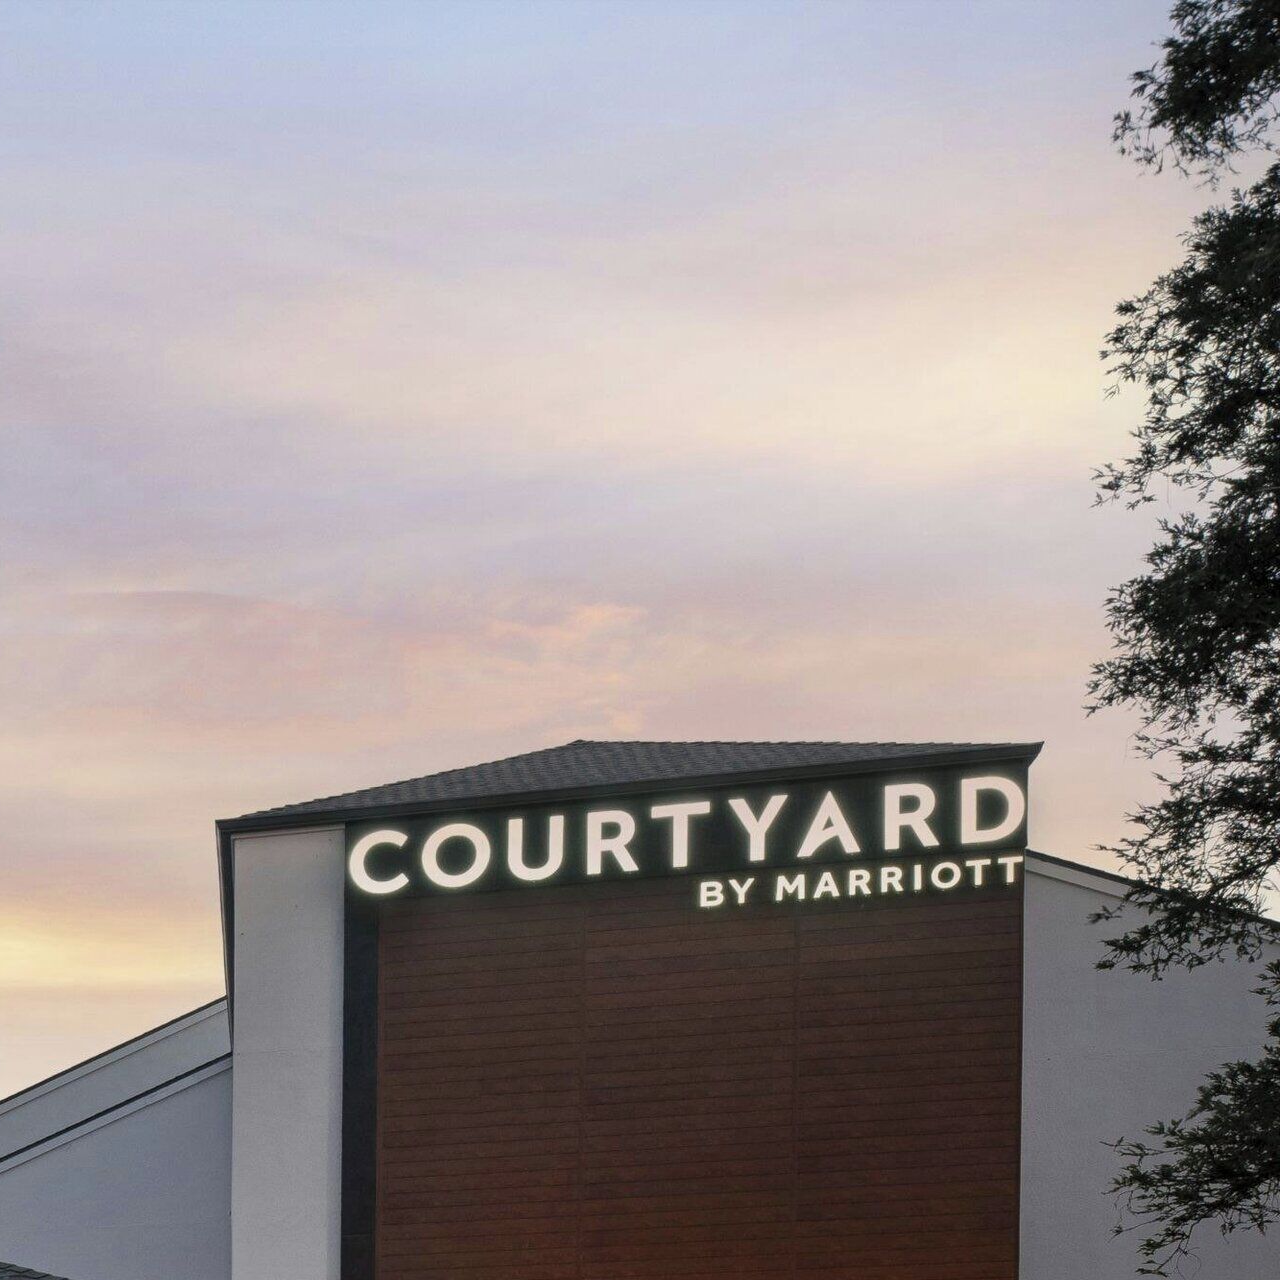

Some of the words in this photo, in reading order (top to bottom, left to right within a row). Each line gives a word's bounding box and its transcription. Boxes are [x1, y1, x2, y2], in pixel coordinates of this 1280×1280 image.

[348, 776, 1026, 895] COURTYARD
[699, 880, 755, 907] BY
[775, 856, 1024, 901] MARRIOTT
